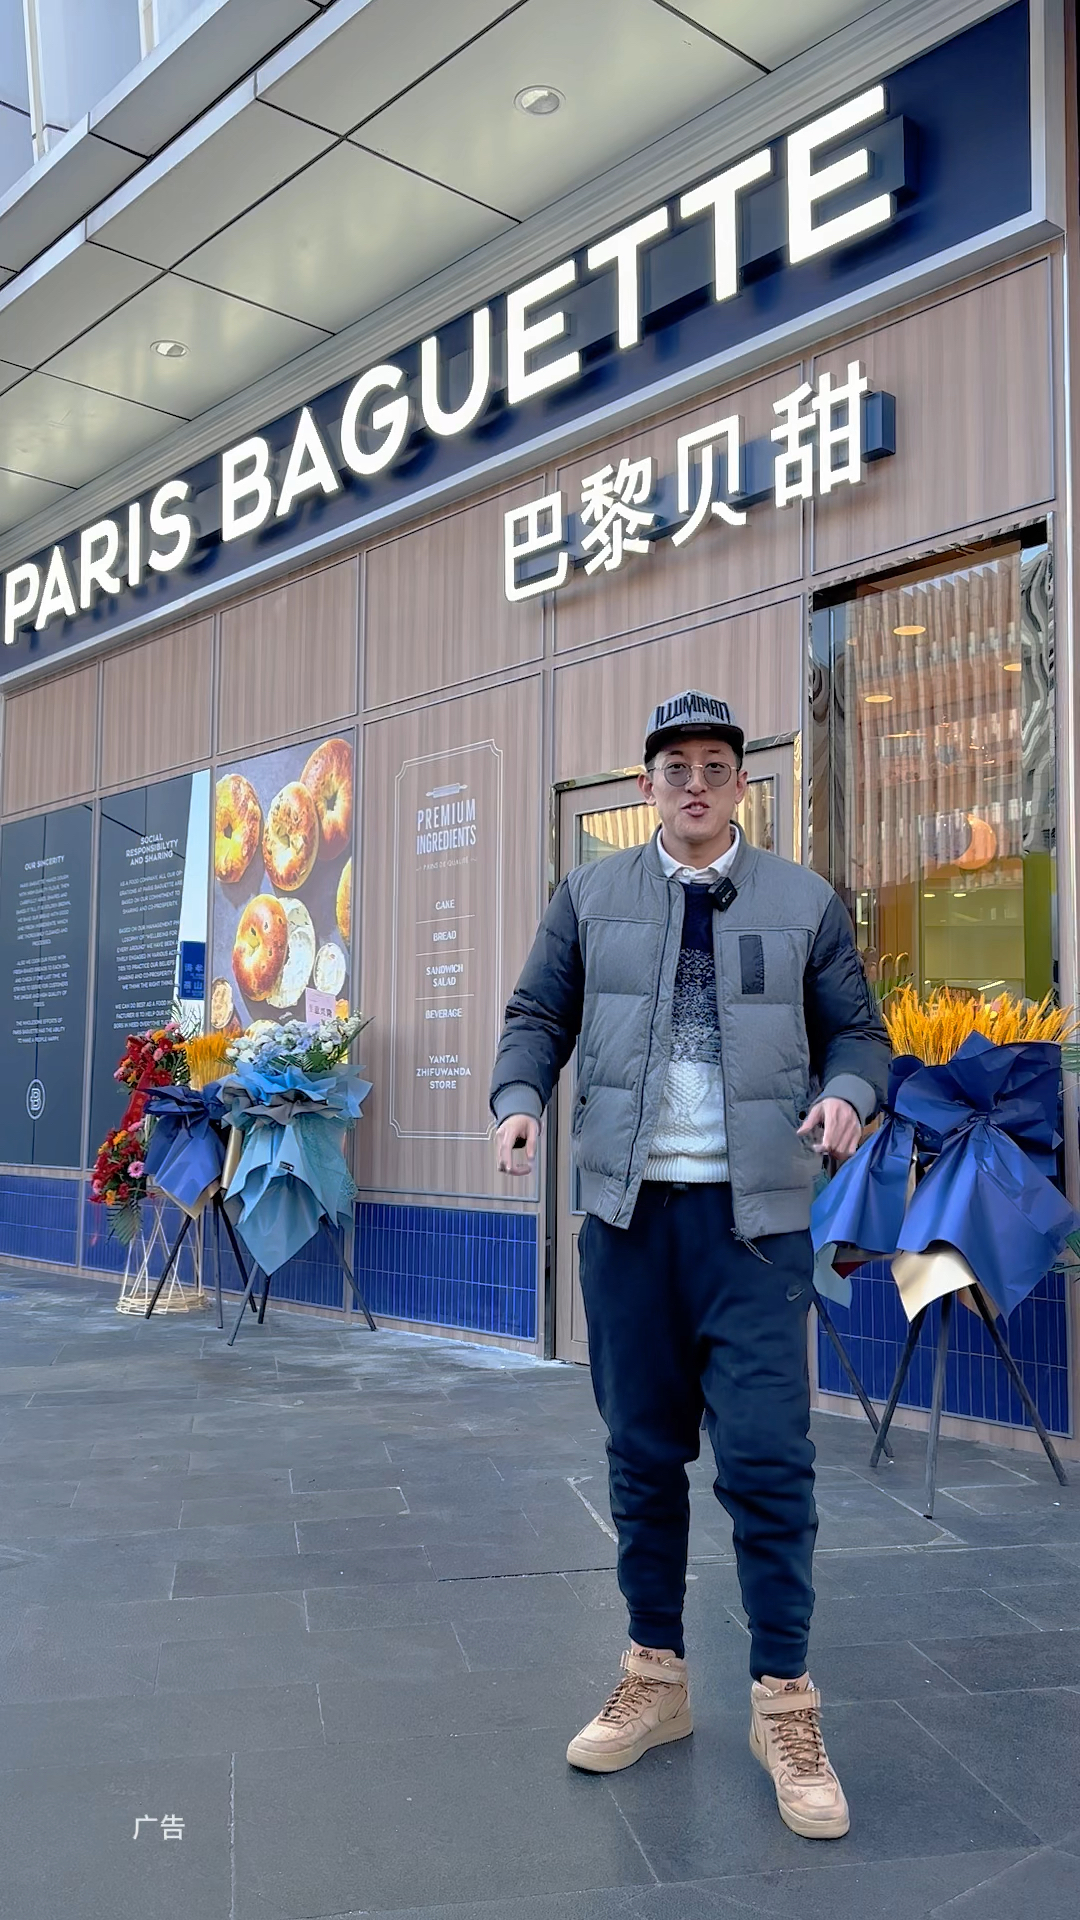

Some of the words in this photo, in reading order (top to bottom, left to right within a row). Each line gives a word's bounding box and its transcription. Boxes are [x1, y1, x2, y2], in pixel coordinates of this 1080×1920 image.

[4, 480, 191, 645] PARIS
[221, 84, 893, 543] BAGUETTE
[504, 359, 871, 603] 巴黎贝甜
[655, 694, 731, 729] ILLUMINATI
[417, 798, 476, 831] PREMIUM
[140, 833, 163, 845] SOCIAL
[416, 824, 476, 855] INGREDIENTS
[24, 862, 36, 871] OUR
[37, 855, 64, 868] SINCERITY
[130, 857, 143, 866] AND
[145, 850, 173, 863] SHARING
[435, 899, 455, 910] CAKE
[433, 930, 457, 941] BREAD
[426, 964, 463, 975] SANDWICH
[432, 976, 456, 987] SALAD
[425, 1007, 462, 1019] BEVERAGE
[429, 1055, 458, 1063] YANTAI
[416, 1067, 471, 1077] ZHIFUWANDA
[429, 1081, 457, 1089] STORE
